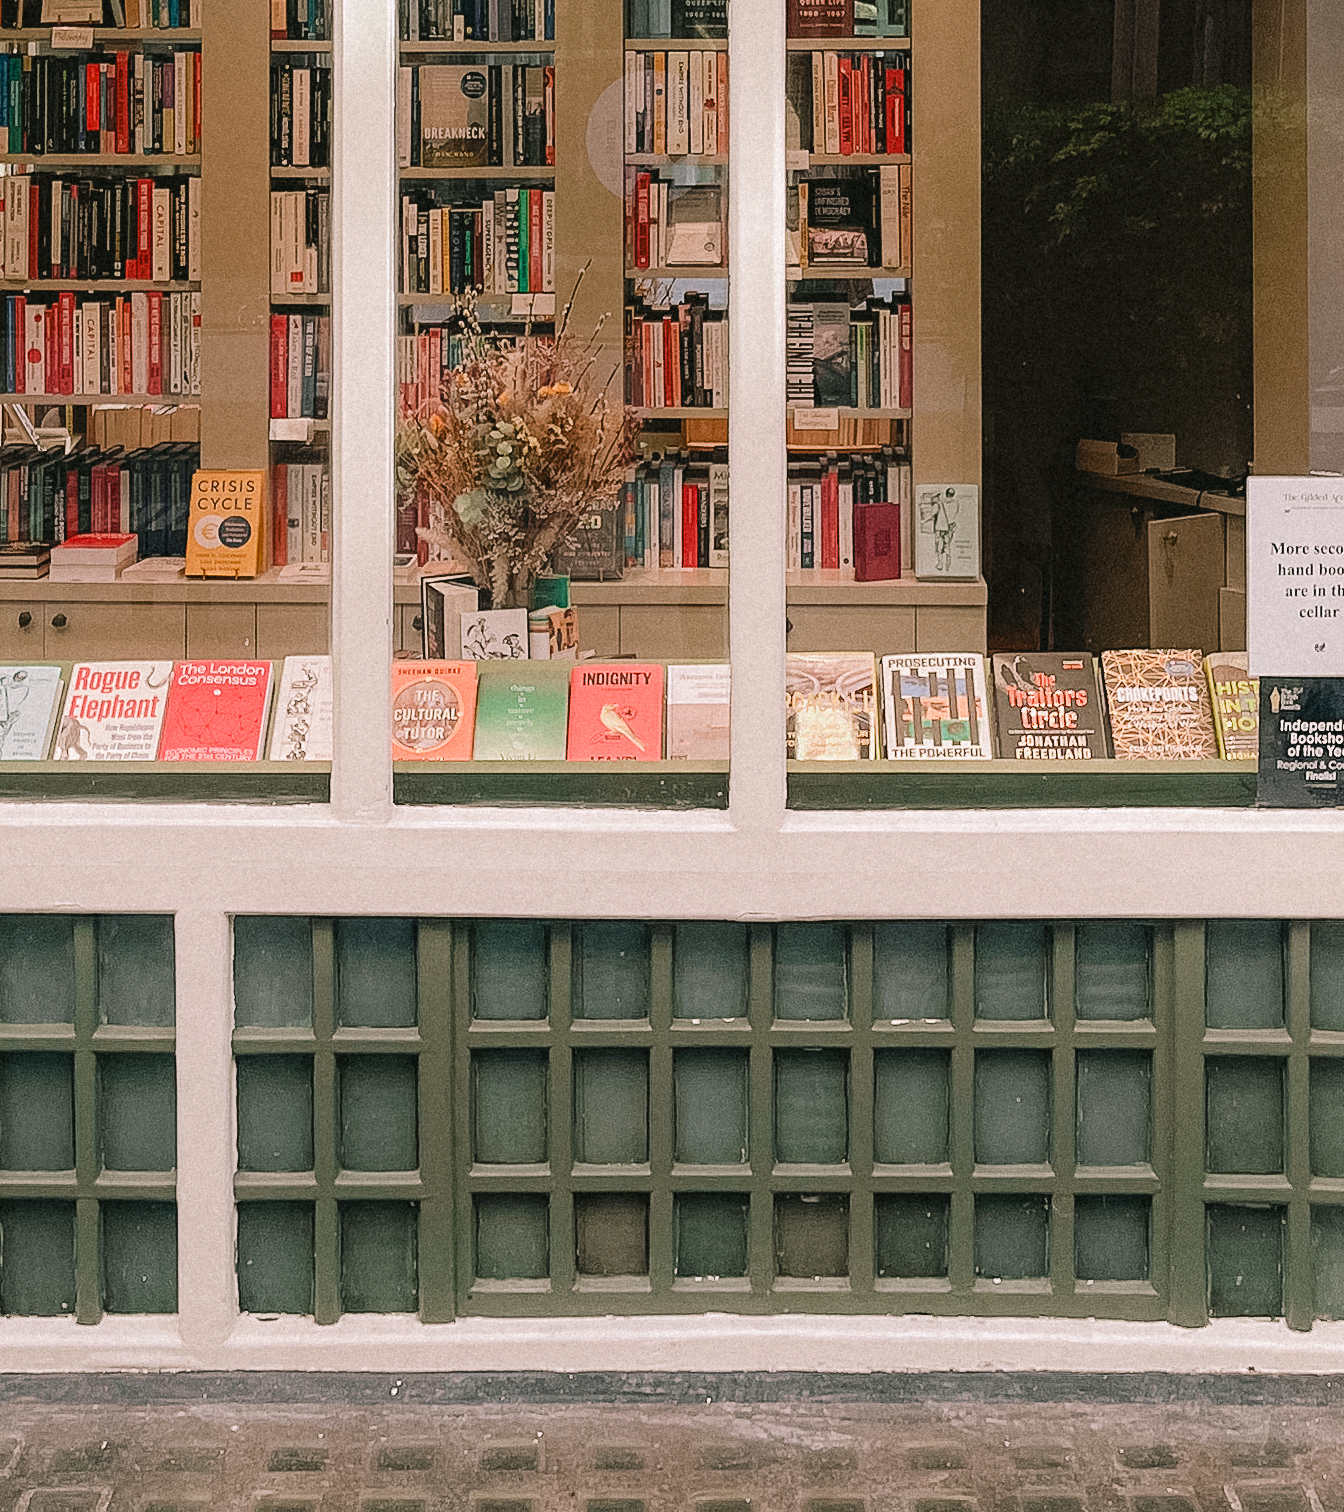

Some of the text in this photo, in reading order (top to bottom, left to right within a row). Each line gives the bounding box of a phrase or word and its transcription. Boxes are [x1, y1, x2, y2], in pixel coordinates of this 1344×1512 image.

[799, 0, 845, 7] QUEER LIFE
[424, 126, 486, 139] BREAKNECK
[156, 204, 165, 248] CAPITAL
[87, 318, 96, 363] CAPITAL
[787, 342, 815, 375] LONG
[197, 480, 255, 493] CRISIS
[197, 497, 253, 510] CYCLE
[1301, 492, 1328, 502] Gilded
[1270, 541, 1310, 555] More
[1278, 563, 1314, 576] hand
[1285, 586, 1308, 597] are
[1313, 584, 1326, 597] in
[1299, 605, 1340, 618] cellar
[179, 662, 265, 676] The London
[888, 657, 976, 669] PROSECUTING
[74, 666, 141, 694] Rogue
[177, 674, 257, 686] Consensus
[582, 671, 652, 686] INDIGNITY
[1033, 672, 1057, 687] The
[1116, 686, 1199, 703] CHOKEPOINTS
[1215, 680, 1260, 696] HIST
[415, 689, 440, 702] THE
[1006, 685, 1088, 708] Traitors
[69, 694, 160, 723] Elephant
[1219, 698, 1242, 714] IN
[394, 707, 458, 721] CULTURAL
[1020, 705, 1079, 729] Circle
[403, 727, 445, 740] TUTOR
[92, 742, 108, 751] Party
[1017, 735, 1087, 748] JONATHAN
[106, 752, 123, 761] Party
[164, 746, 254, 755] ECONOMIC PRINCIPLES
[214, 753, 253, 761] CENTURY
[891, 747, 987, 758] THE POWERFUL
[1014, 747, 1093, 760] FREEDLAND
[1287, 744, 1301, 758] of
[1302, 744, 1324, 758] the
[1276, 759, 1318, 772] Regional
[1318, 760, 1327, 770] &
[1305, 770, 1337, 782] Finalist
